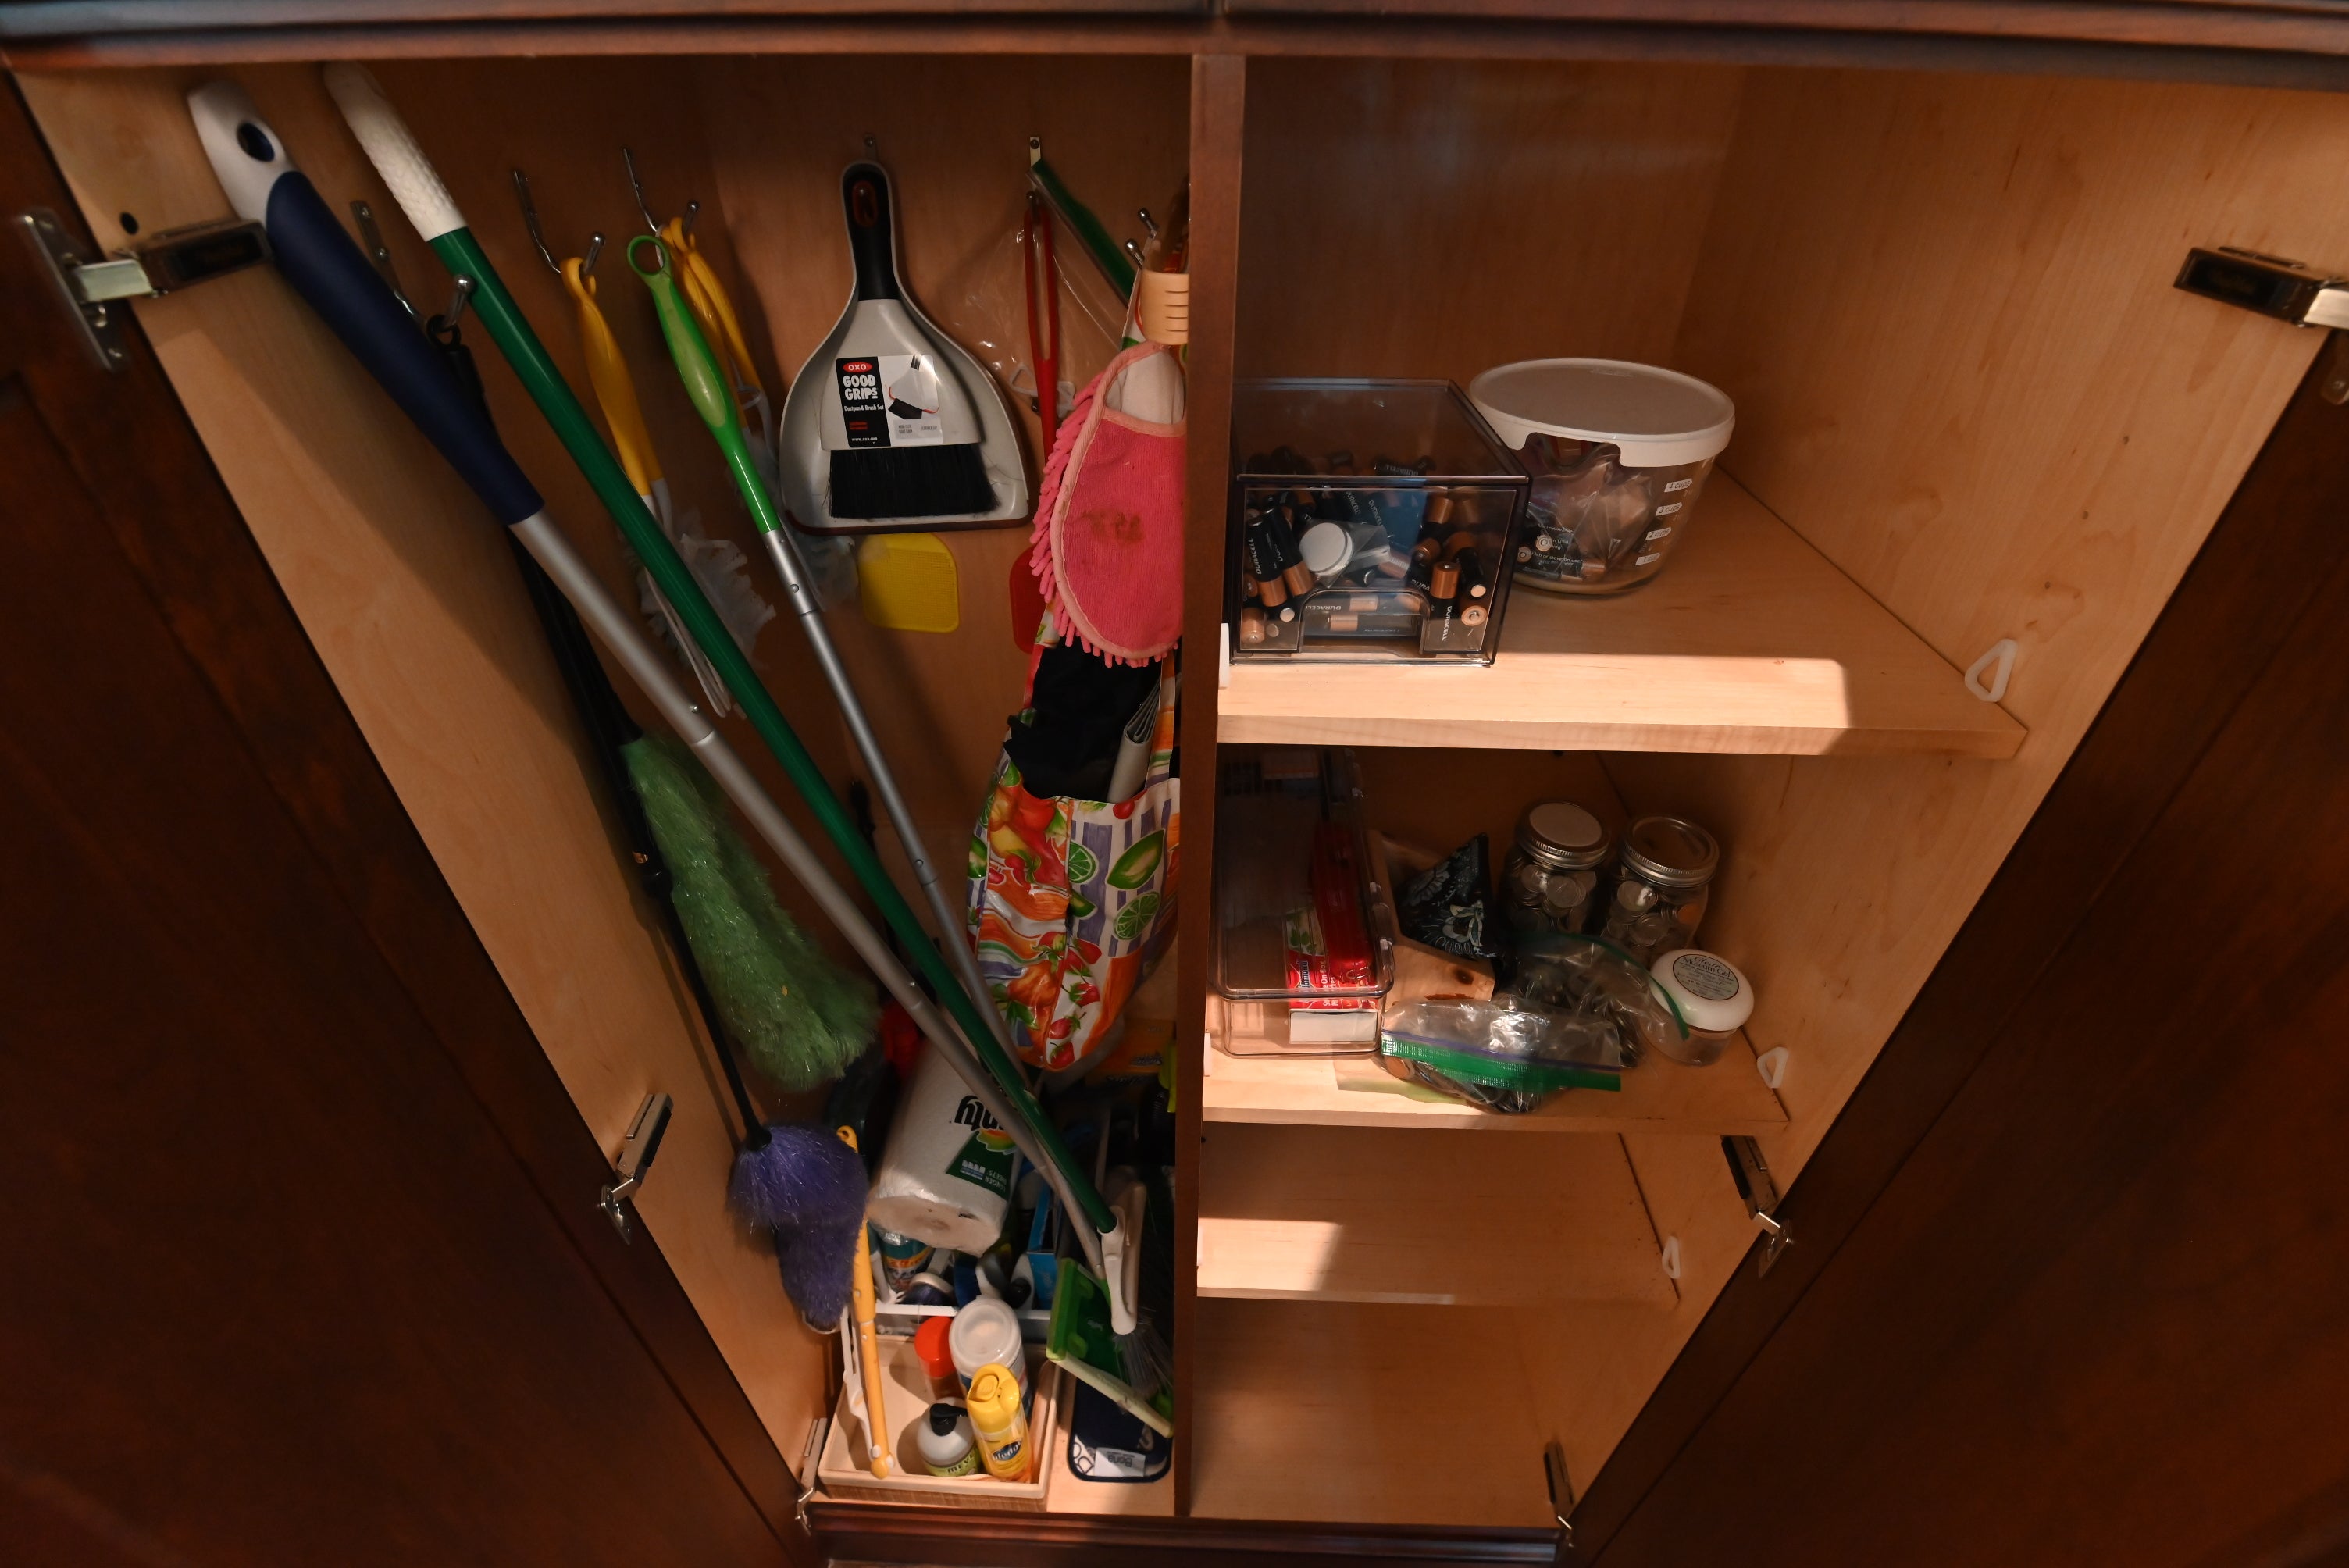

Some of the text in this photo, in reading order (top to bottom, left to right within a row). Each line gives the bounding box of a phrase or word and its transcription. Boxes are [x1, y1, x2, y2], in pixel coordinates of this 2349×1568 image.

[843, 374, 876, 388] GOOD
[844, 387, 878, 401] GRIPS
[1674, 481, 1691, 490] cups
[1247, 536, 1262, 576] DURACELL
[1442, 605, 1453, 642] DURACELL
[1683, 957, 1731, 978] Museum Gel
[1694, 957, 1721, 968] Clear
[1297, 960, 1310, 989] iamond
[1321, 974, 1328, 984] On
[954, 1095, 1004, 1131] nty
[1107, 1454, 1132, 1468] Bona
